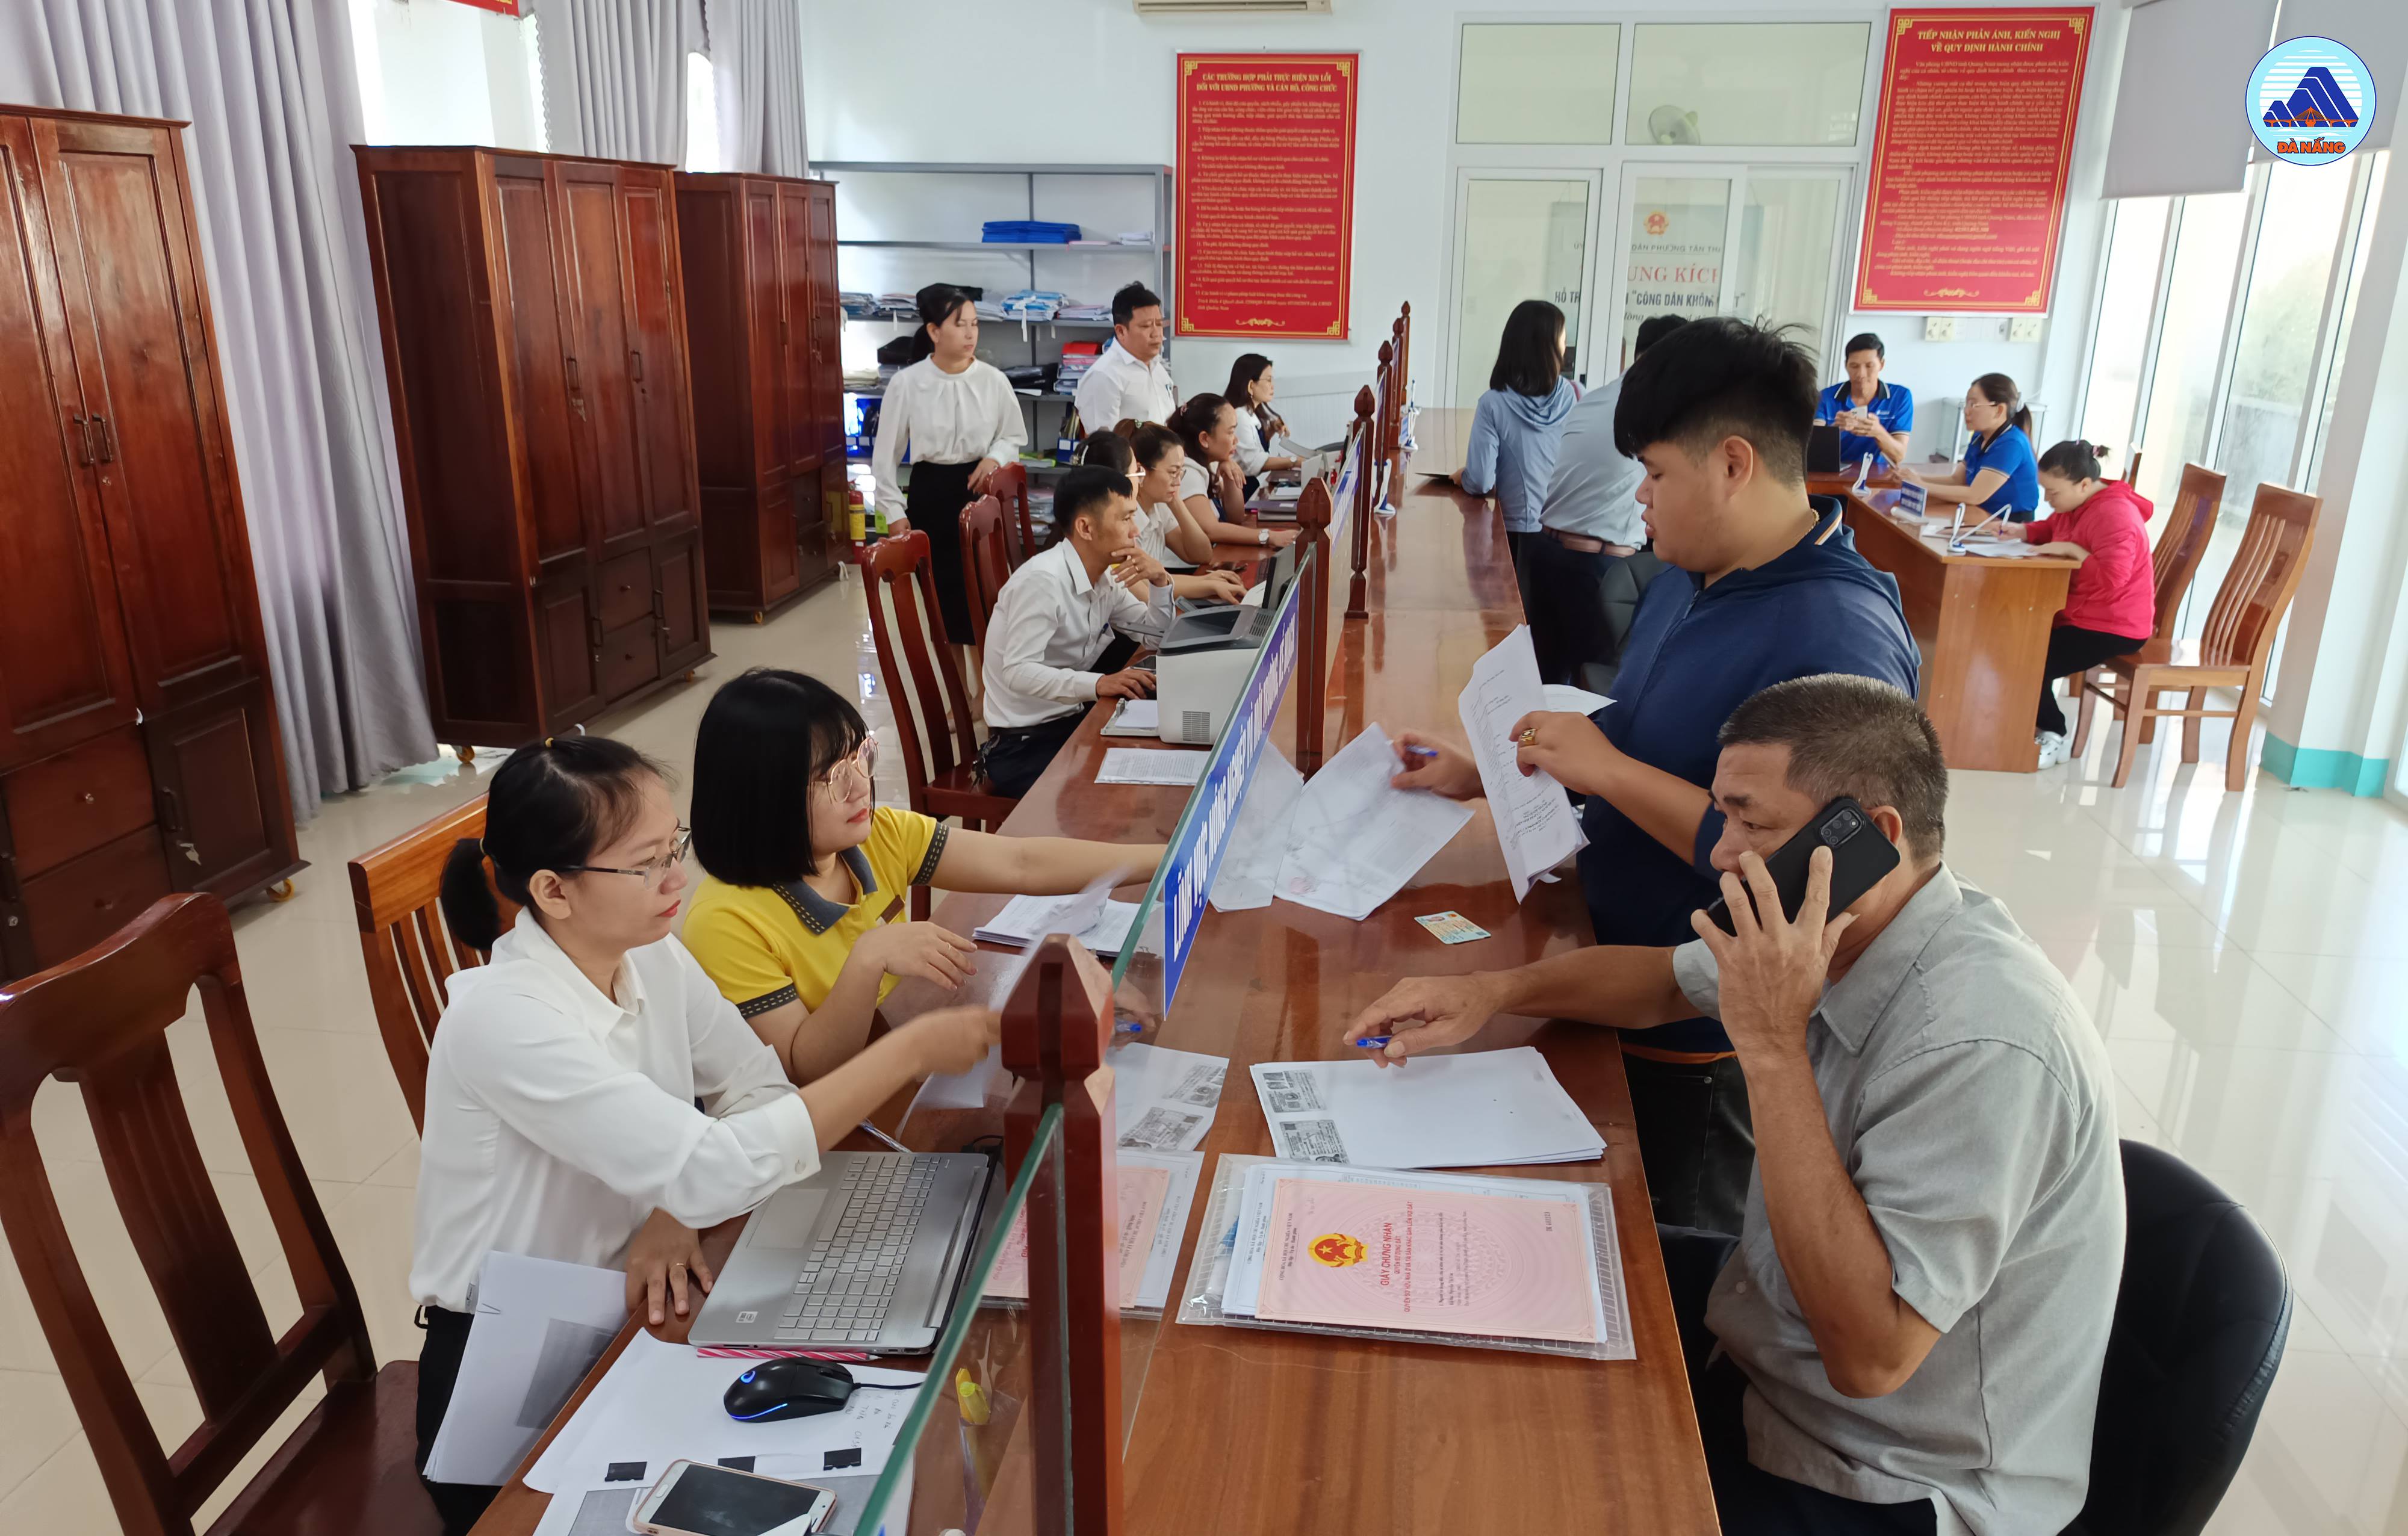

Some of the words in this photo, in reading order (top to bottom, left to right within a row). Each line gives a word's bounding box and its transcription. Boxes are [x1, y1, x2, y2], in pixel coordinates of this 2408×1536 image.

[1918, 29, 1938, 40] TIẾP
[1940, 31, 1964, 41] NHẬN
[1966, 29, 1990, 40] PHẢN
[1991, 29, 2012, 40] ÁNH,
[2014, 29, 2037, 39] KIẾN
[2038, 30, 2060, 40] NGHỊ
[1931, 42, 1942, 52] VỀ
[1944, 44, 1963, 54] QUY
[1964, 44, 1986, 54] ĐỊNH
[1988, 43, 2012, 52] HÀNH
[2015, 42, 2043, 52] CHÍNH
[1267, 83, 1274, 91] VÀ
[1276, 83, 1289, 91] CÁN
[1302, 83, 1318, 92] CÔNG
[1628, 266, 1667, 282] UNG
[1665, 291, 1683, 306] DÂN
[1174, 856, 1193, 962] LĨNH
[1194, 820, 1208, 909] VỰC
[1209, 775, 1226, 869] NÔNG
[1227, 724, 1246, 821] NGHIỆP
[1247, 701, 1253, 769] VÀ
[1253, 682, 1263, 752] MÔI
